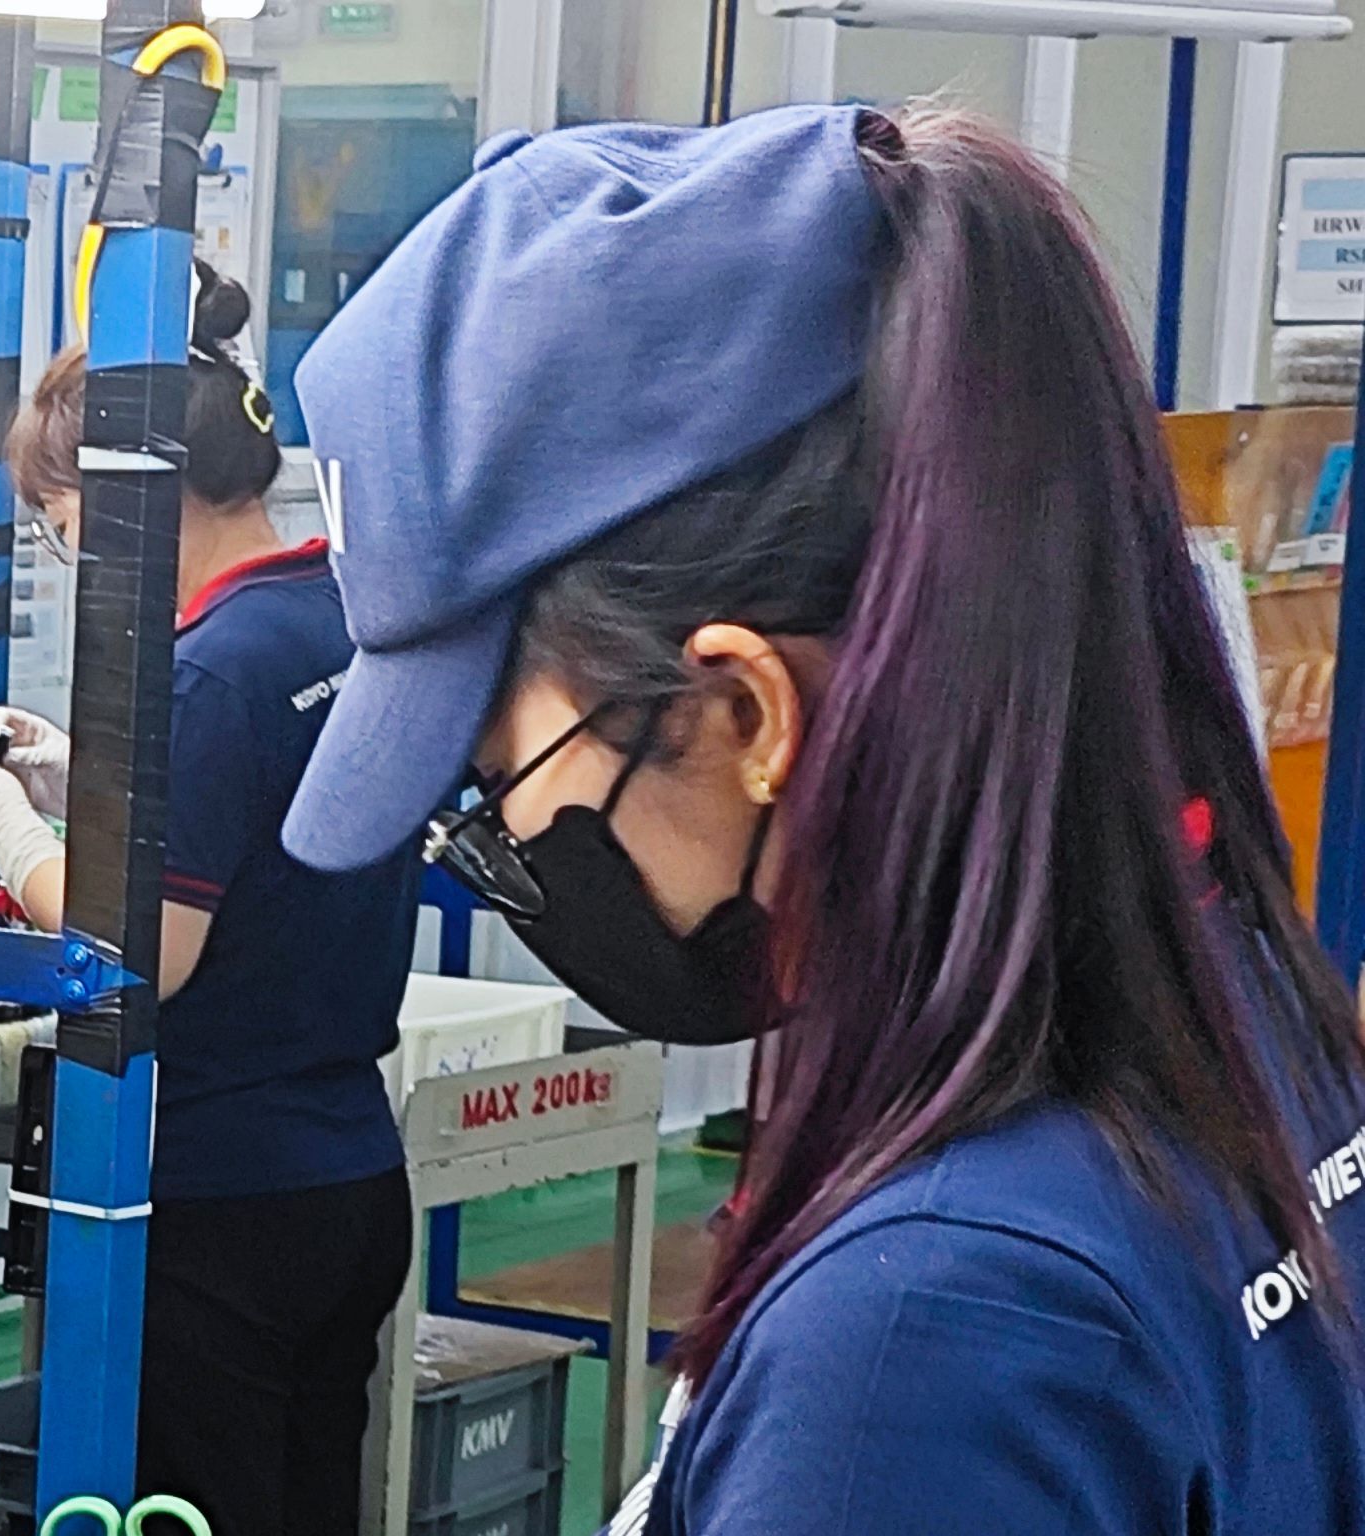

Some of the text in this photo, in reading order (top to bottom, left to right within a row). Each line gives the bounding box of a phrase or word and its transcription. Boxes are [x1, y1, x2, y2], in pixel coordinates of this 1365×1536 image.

[1313, 216, 1365, 233] HRW
[461, 1081, 520, 1131] MAX
[1309, 1125, 1365, 1209] VIET
[1241, 1249, 1311, 1341] KOY
[461, 1408, 515, 1461] KMV
